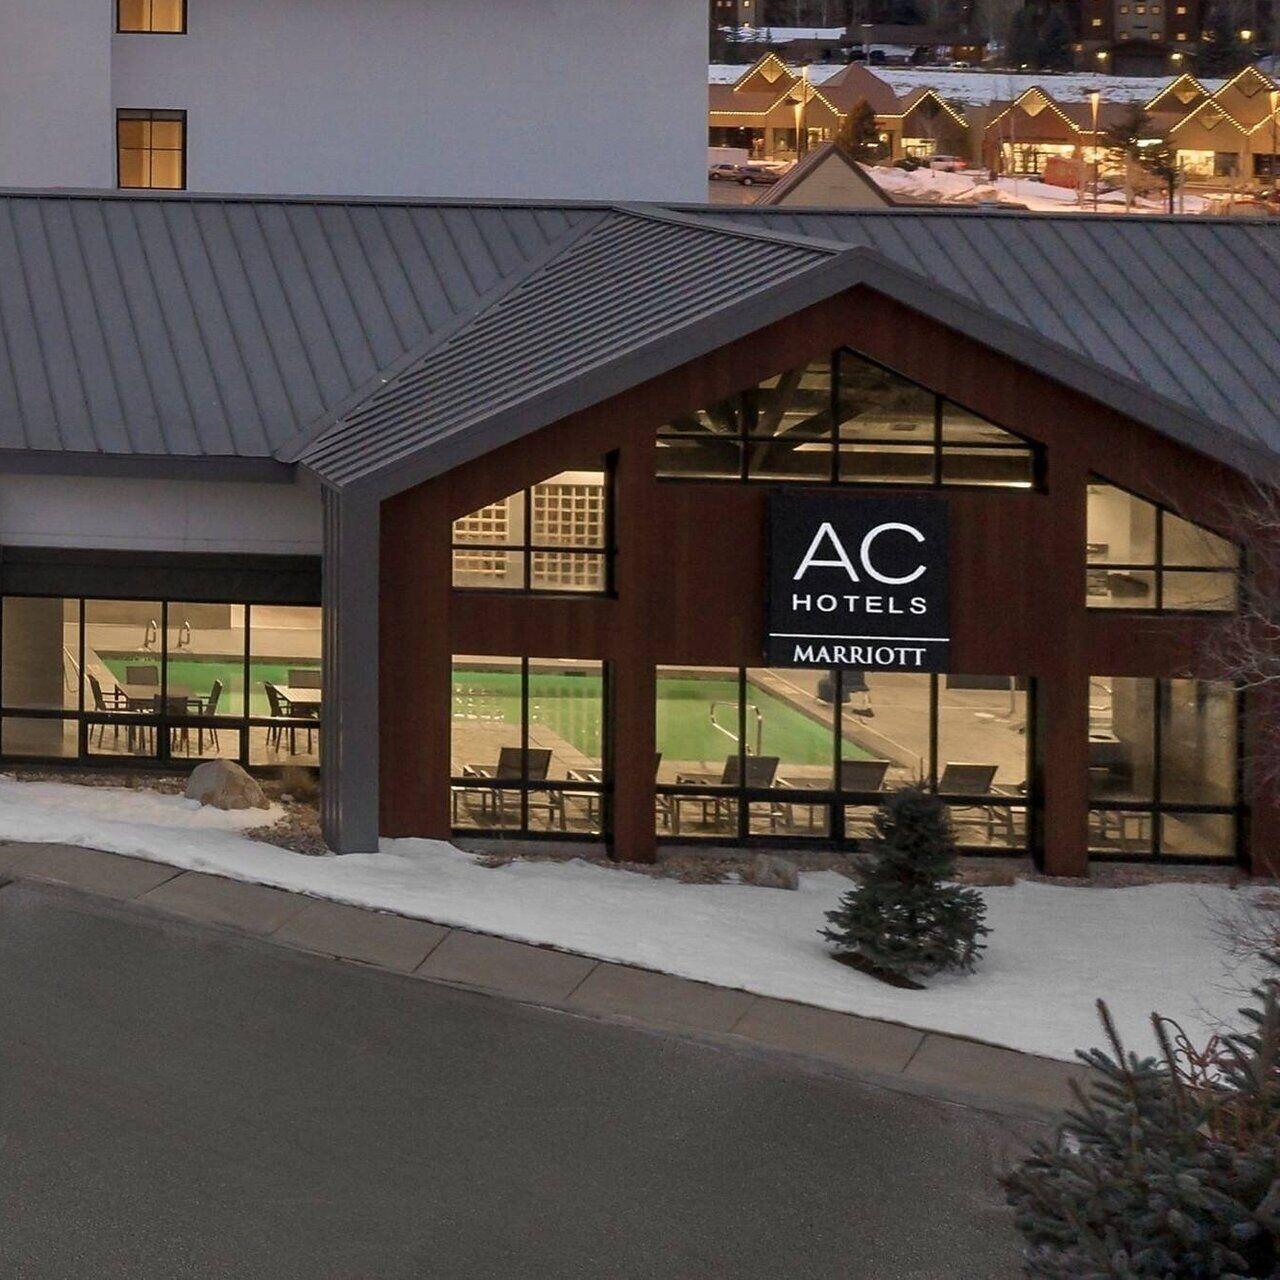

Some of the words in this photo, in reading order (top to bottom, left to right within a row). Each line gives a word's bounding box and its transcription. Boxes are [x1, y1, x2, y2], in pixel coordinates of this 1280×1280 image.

[793, 522, 927, 585] AC
[792, 594, 927, 615] HOTELS
[793, 645, 927, 666] MARRIOTT
